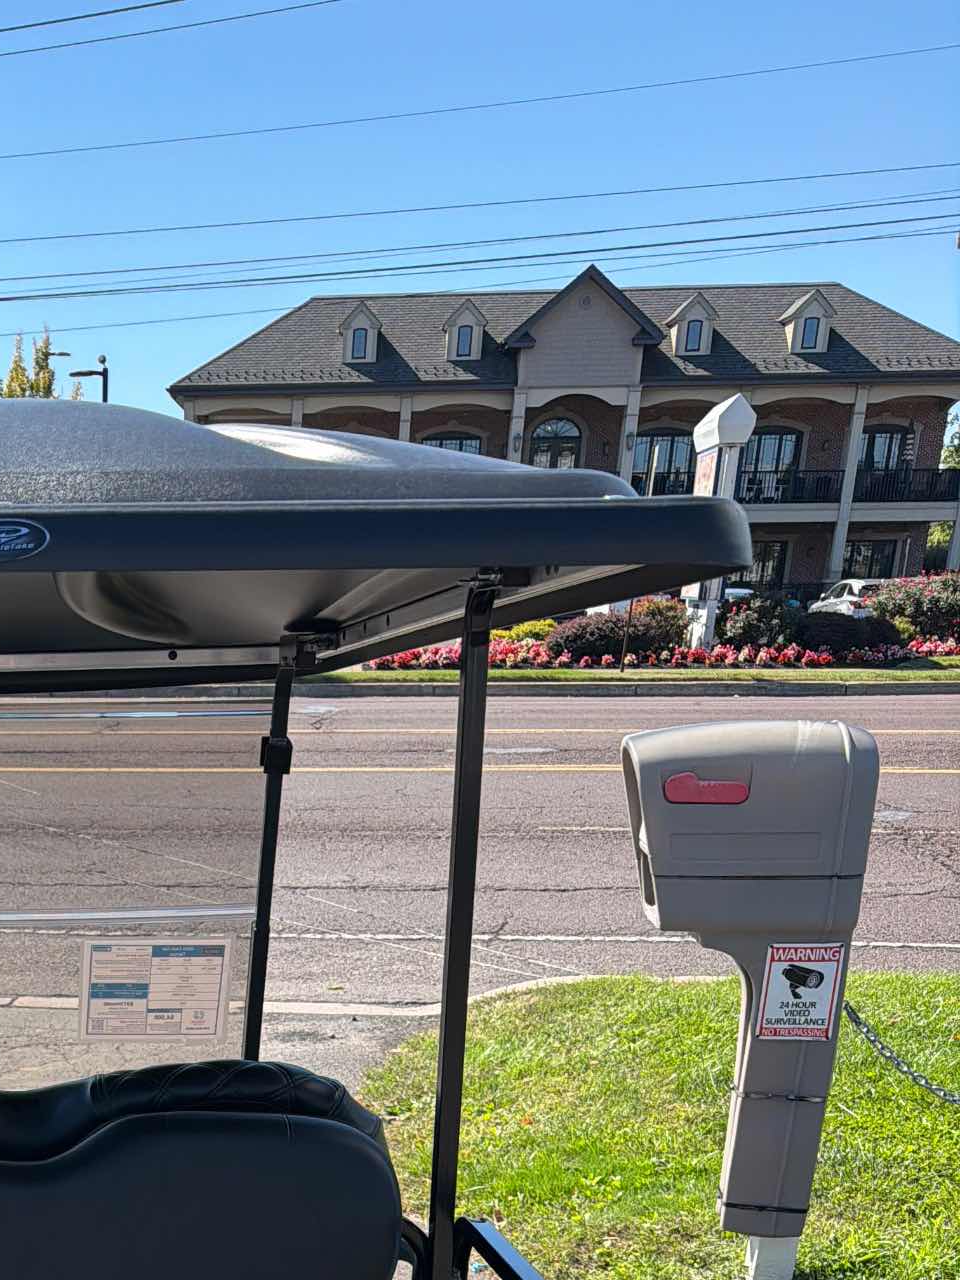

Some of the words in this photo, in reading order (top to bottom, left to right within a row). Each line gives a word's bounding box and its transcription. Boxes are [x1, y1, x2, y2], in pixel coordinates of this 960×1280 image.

[773, 947, 840, 960] WARNING
[779, 1001, 790, 1009] 24
[791, 1001, 817, 1009] HOUR
[784, 1009, 810, 1017] VIDEO
[765, 1018, 827, 1026] SURVEILLANCE
[761, 1028, 775, 1036] NO
[776, 1028, 825, 1037] TRESPASSING
